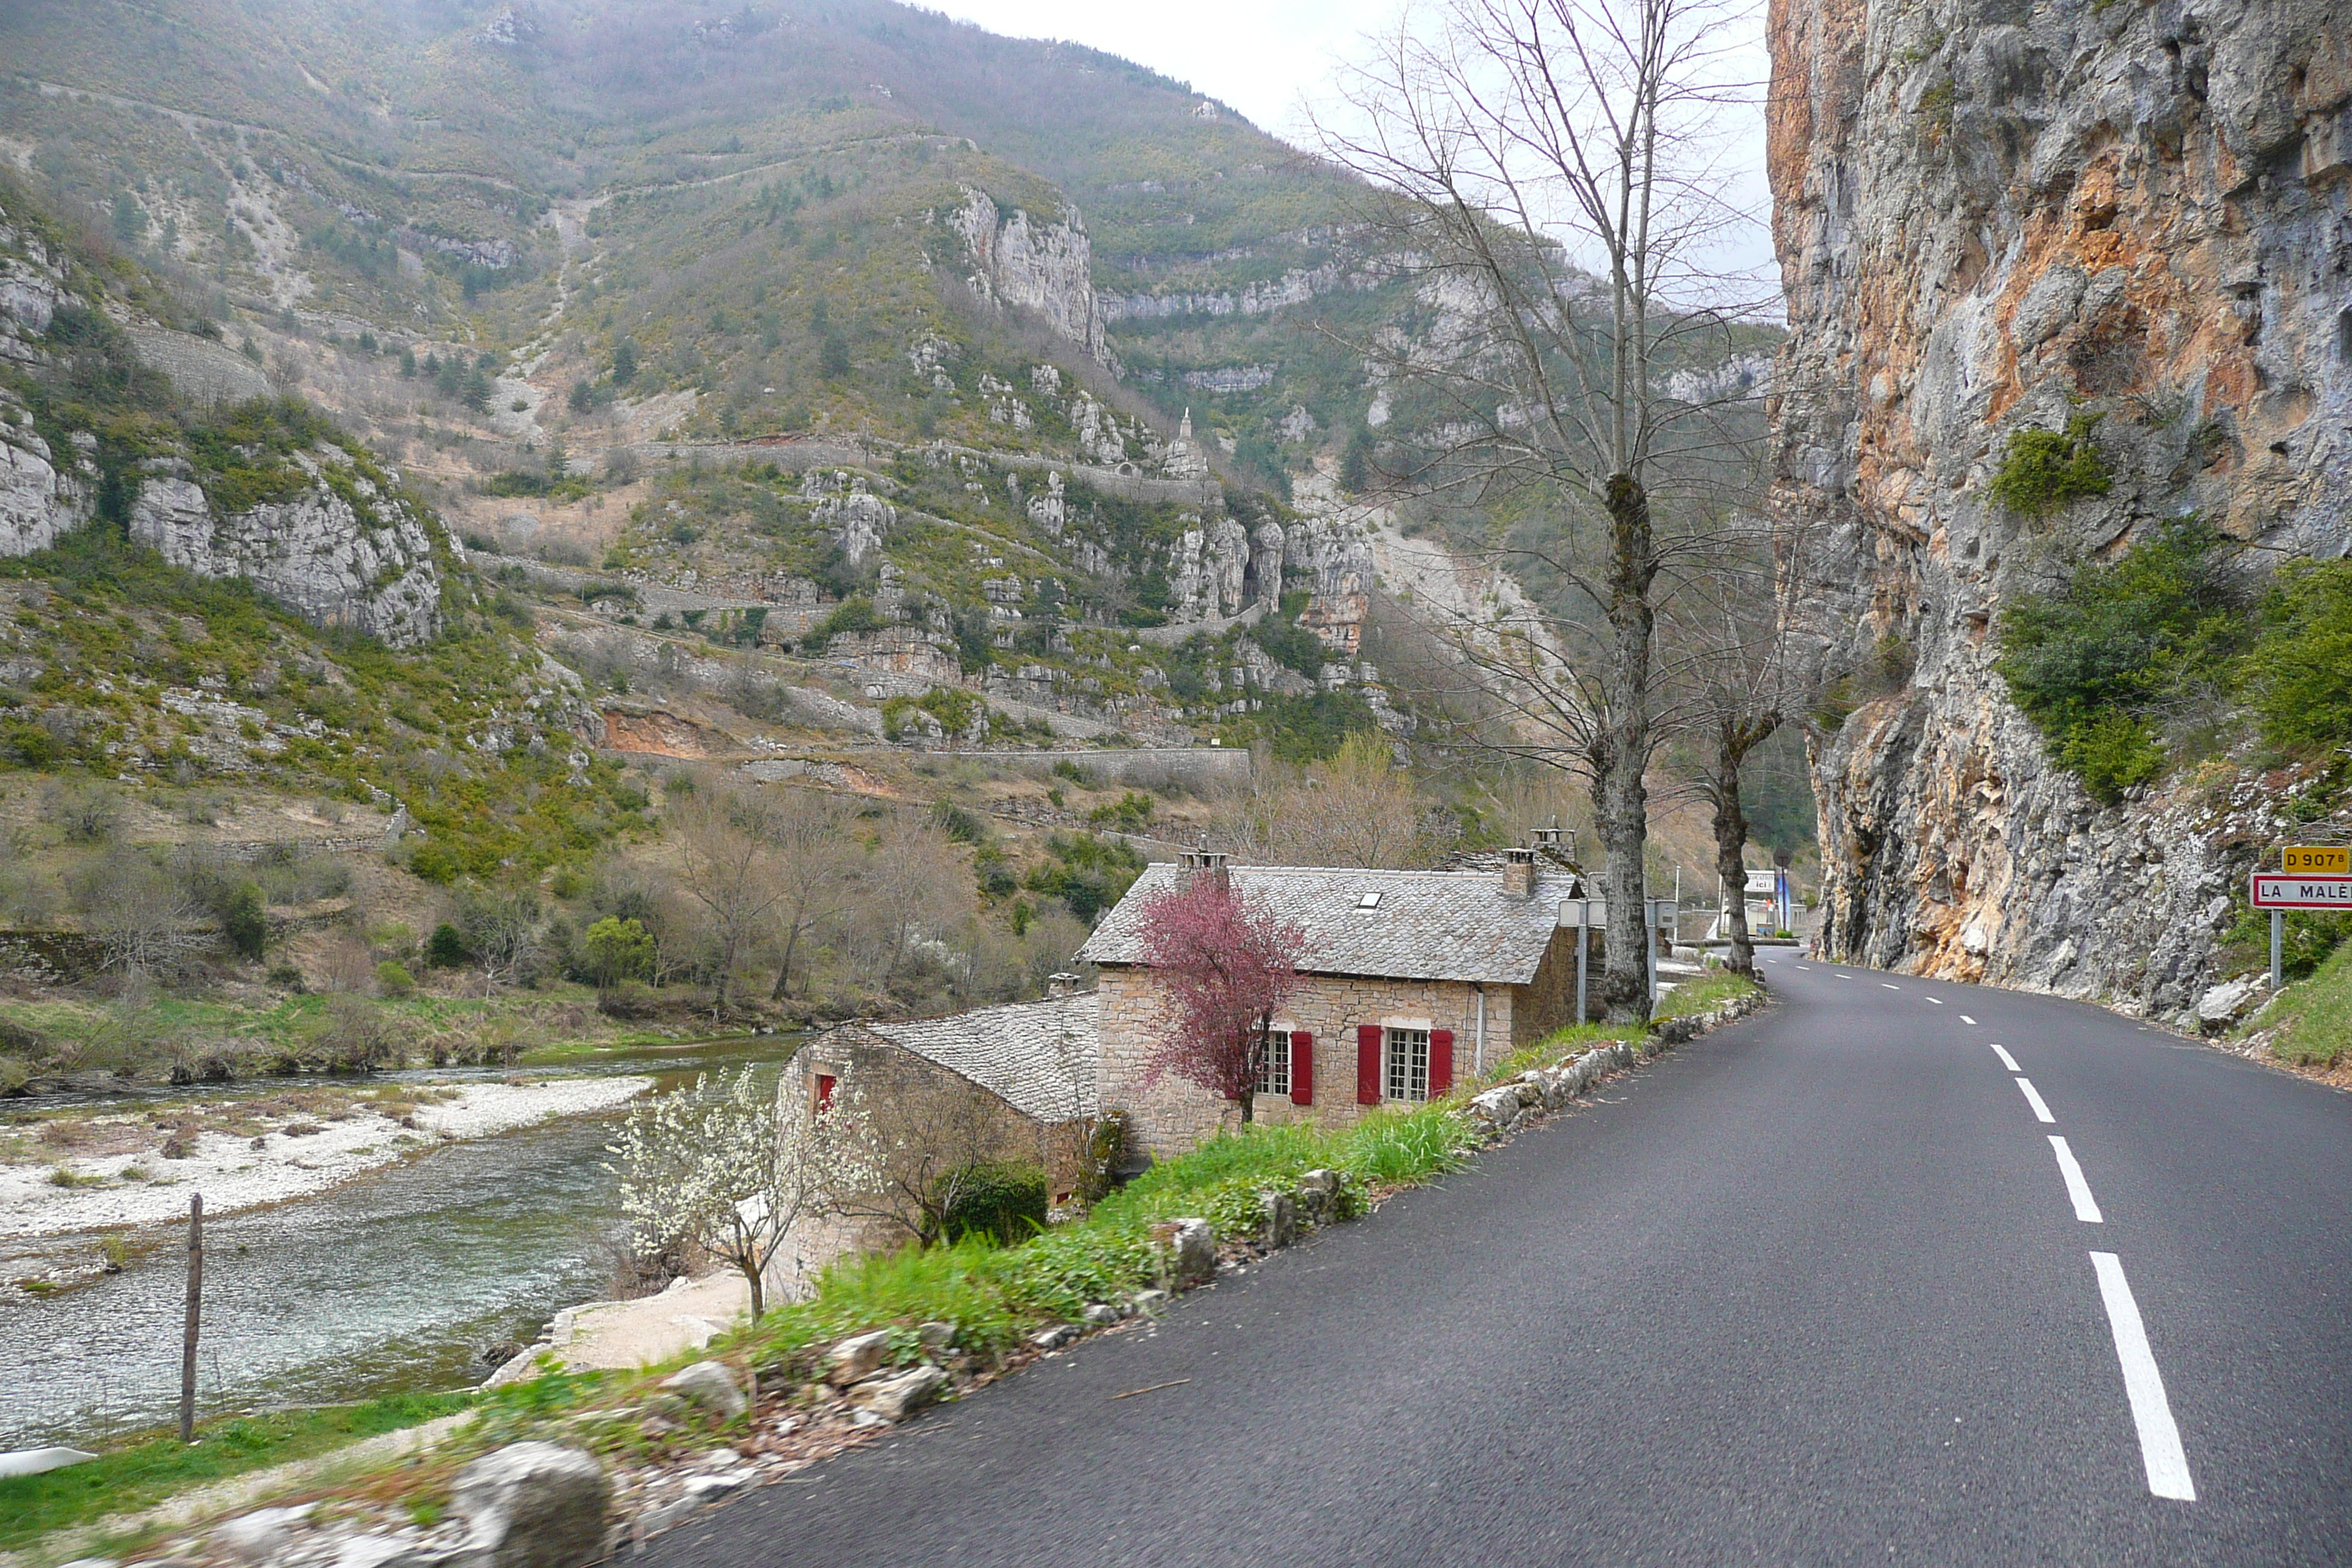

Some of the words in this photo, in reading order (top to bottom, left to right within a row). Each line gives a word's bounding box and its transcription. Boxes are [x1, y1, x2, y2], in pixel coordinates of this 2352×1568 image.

[2287, 854, 2296, 866] D
[2261, 885, 2281, 897] LA
[2300, 883, 2352, 898] MALÈ
